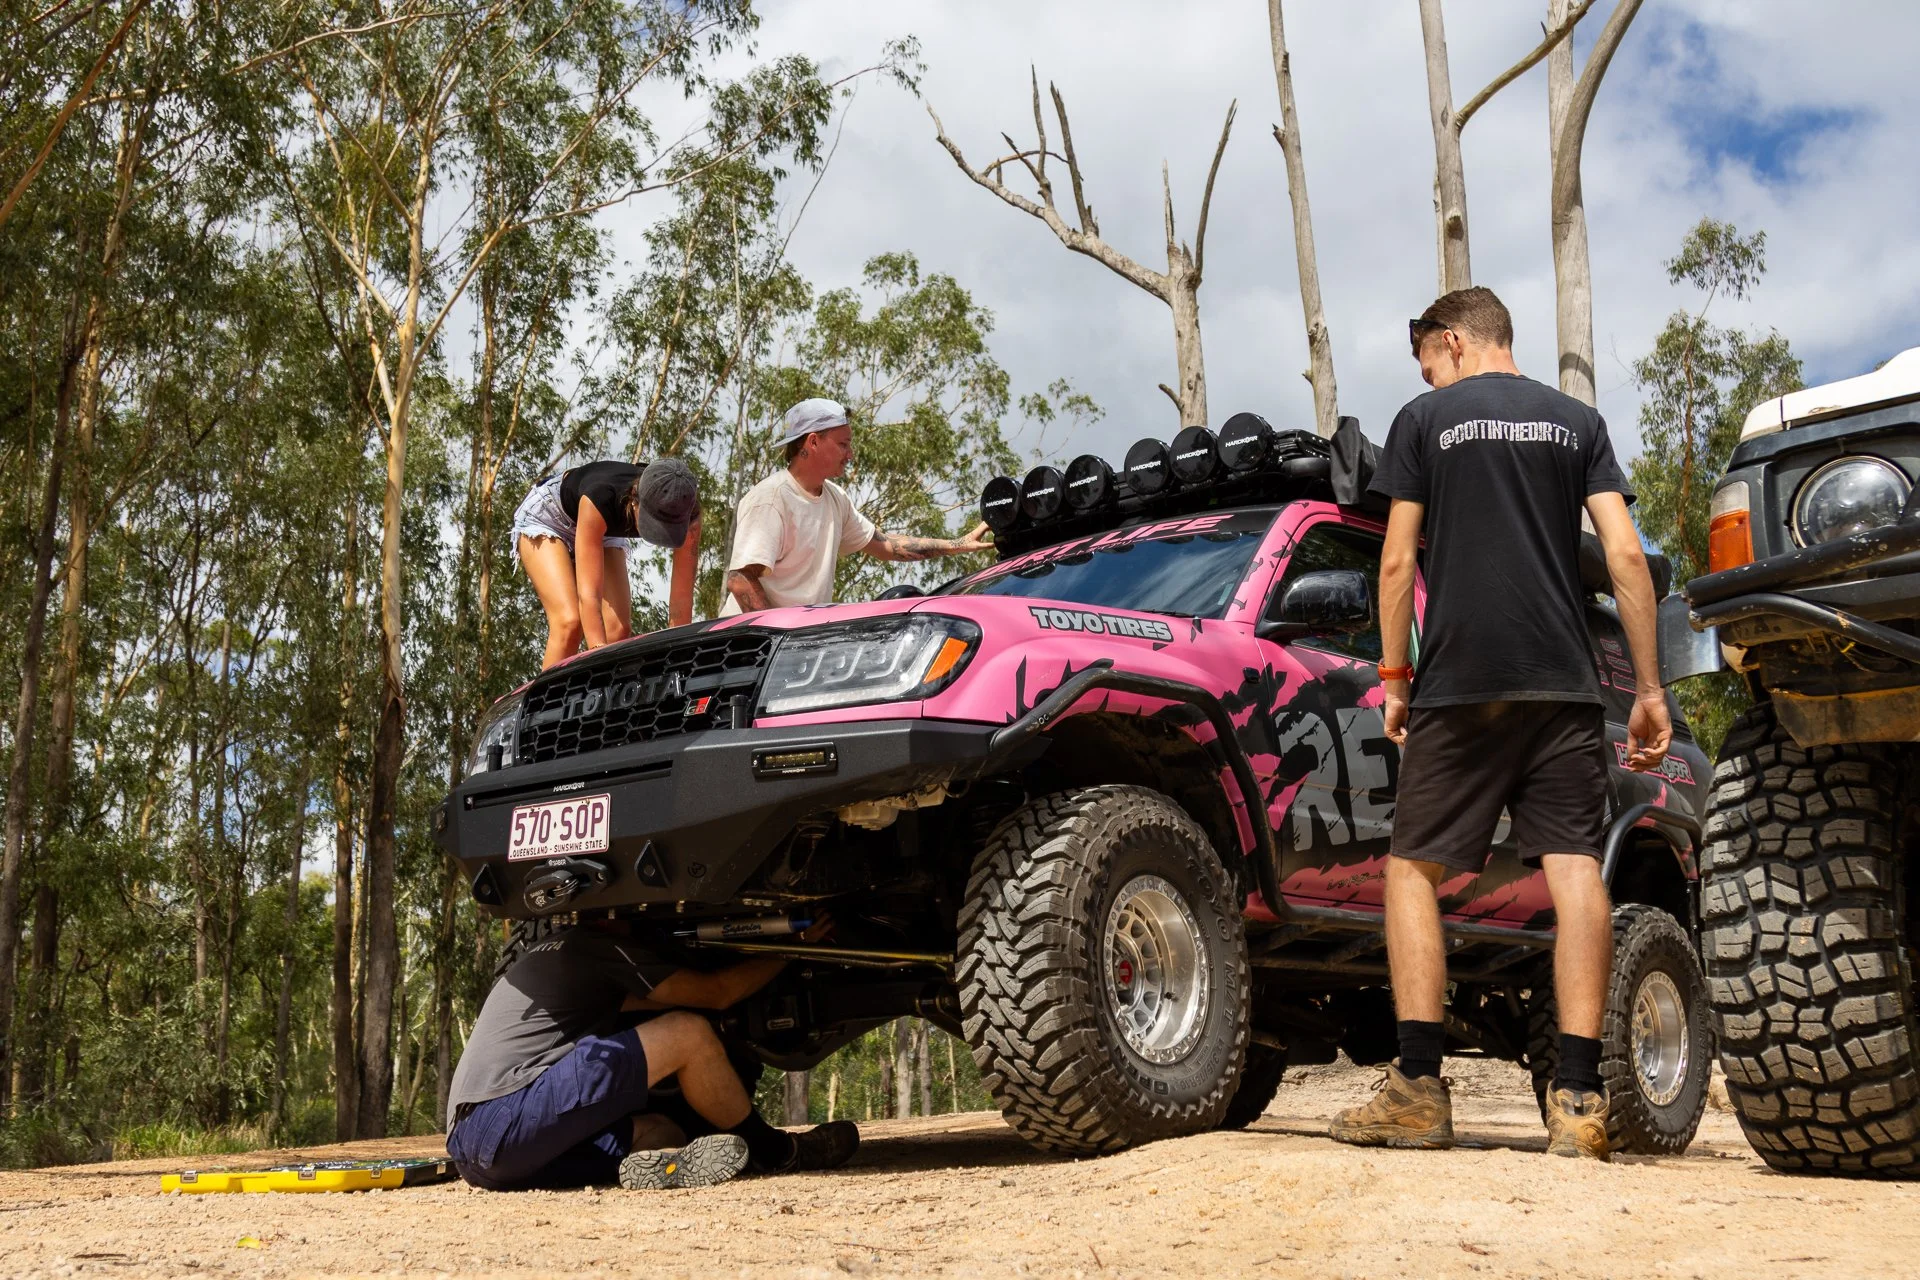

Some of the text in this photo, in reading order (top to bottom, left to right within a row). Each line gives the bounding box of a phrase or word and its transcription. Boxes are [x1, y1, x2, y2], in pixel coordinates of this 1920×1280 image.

[1089, 514, 1234, 548] LIFE
[564, 671, 683, 720] TOYOTA
[512, 846, 548, 858] QUEENSLAND
[553, 843, 582, 853] SUNSHINE
[585, 840, 603, 850] STATE
